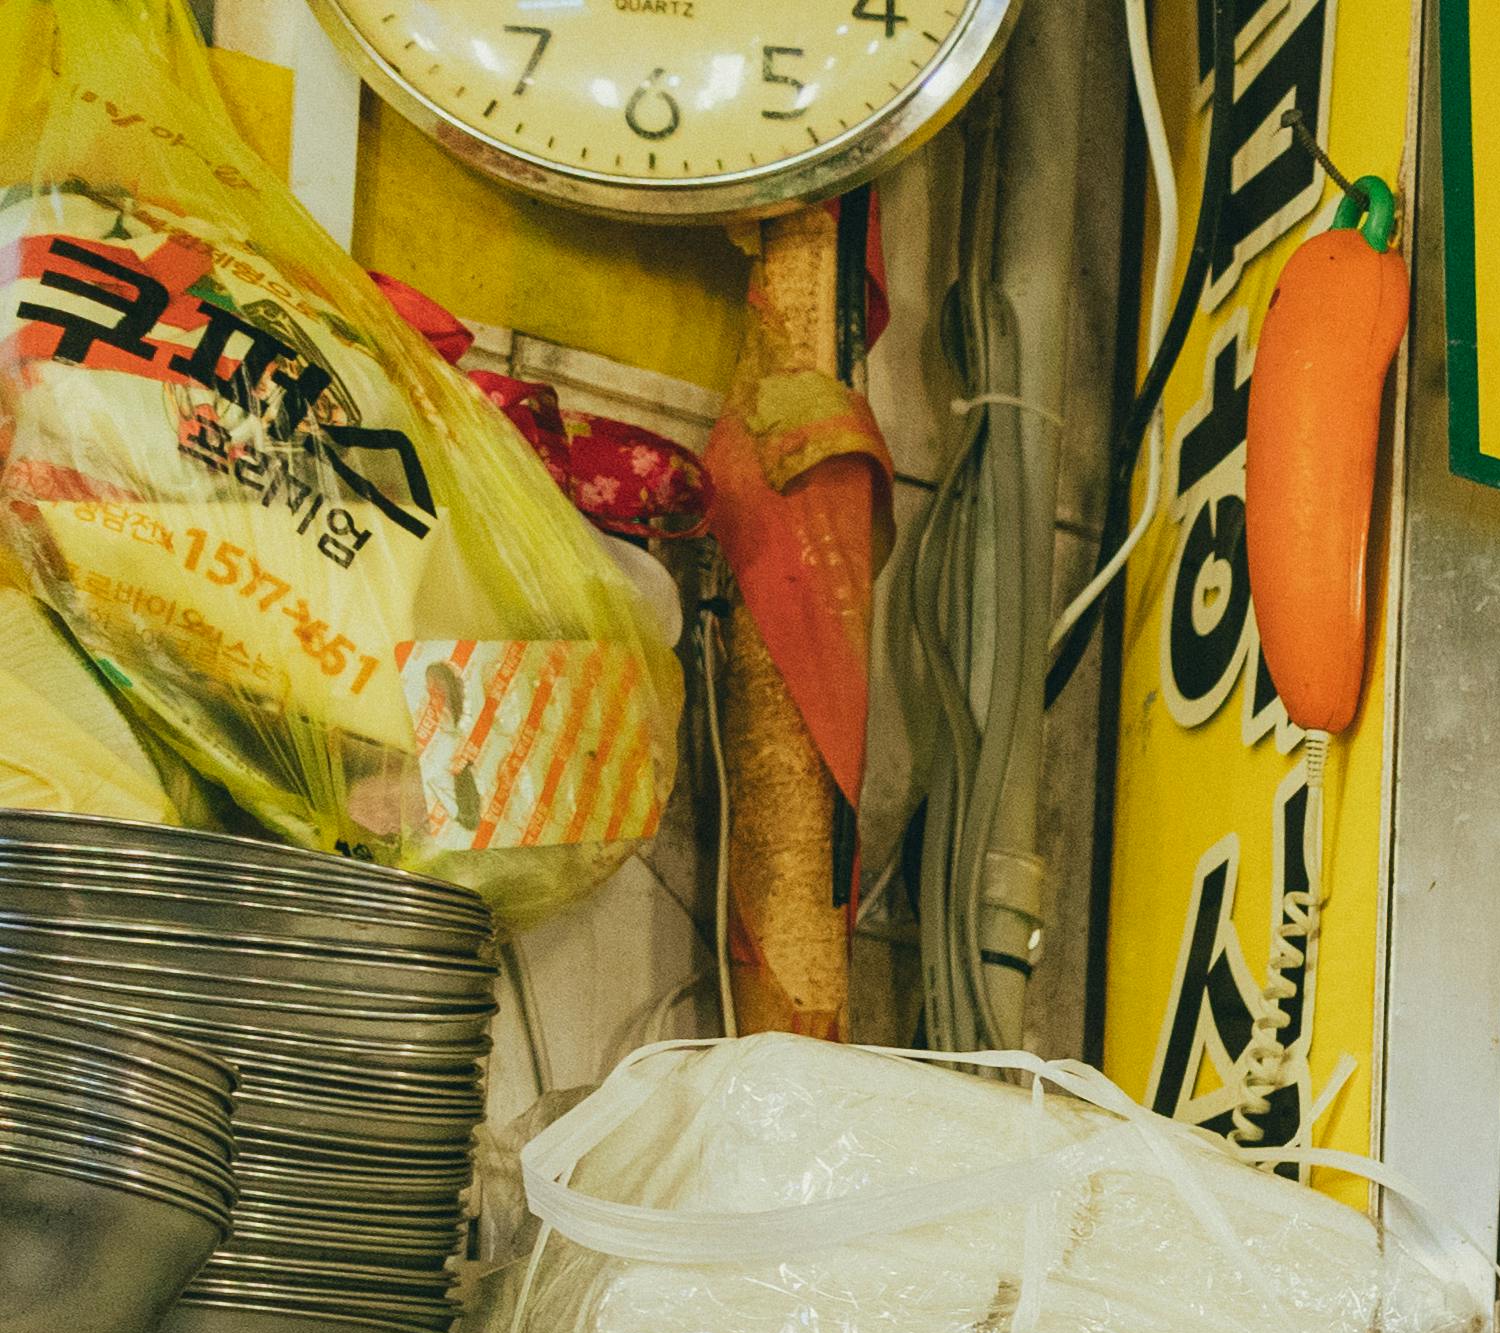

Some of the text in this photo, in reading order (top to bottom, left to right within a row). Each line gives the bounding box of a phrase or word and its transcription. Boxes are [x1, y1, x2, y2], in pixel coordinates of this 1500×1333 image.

[614, 0, 694, 18] QUARTZ
[852, 0, 908, 38] 4
[504, 25, 552, 97] 7
[761, 46, 806, 120] 5
[624, 67, 680, 140] 6
